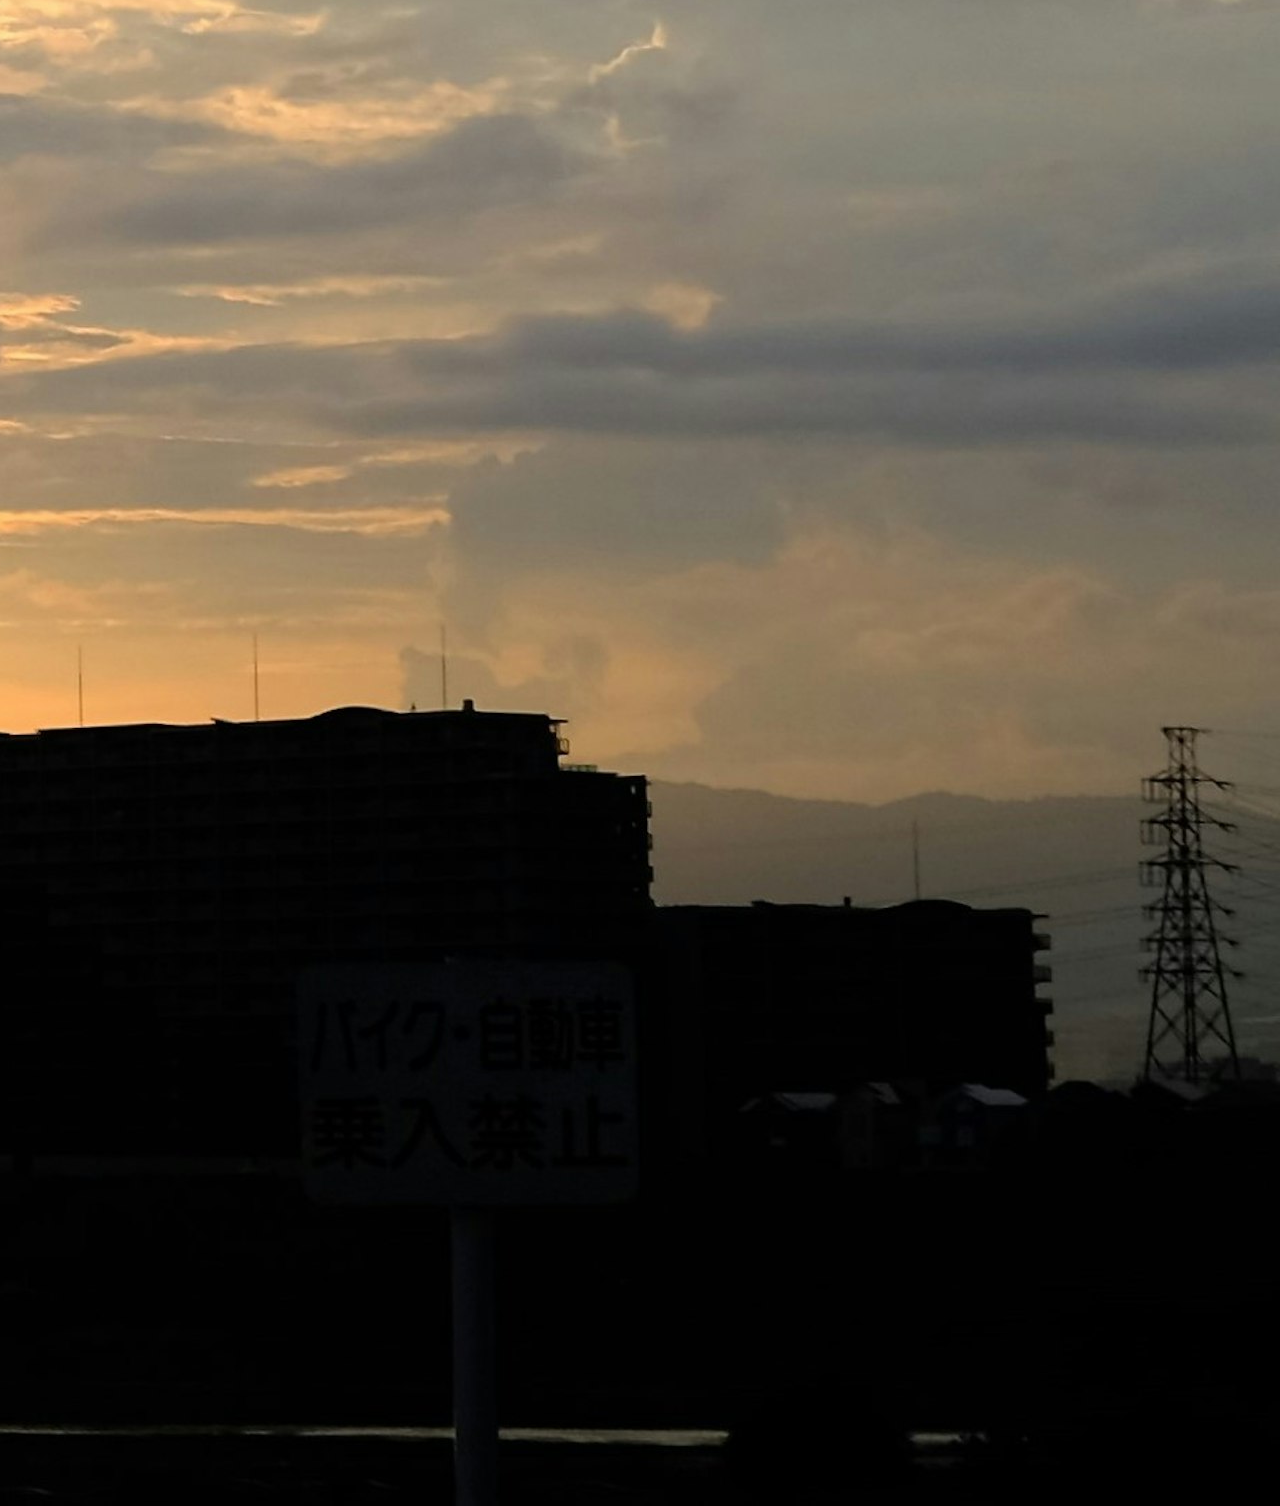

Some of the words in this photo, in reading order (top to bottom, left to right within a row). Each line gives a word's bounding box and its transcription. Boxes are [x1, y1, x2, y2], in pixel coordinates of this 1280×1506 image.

[311, 995, 625, 1072] バイク・自動車
[311, 1093, 628, 1171] 乗入禁止
